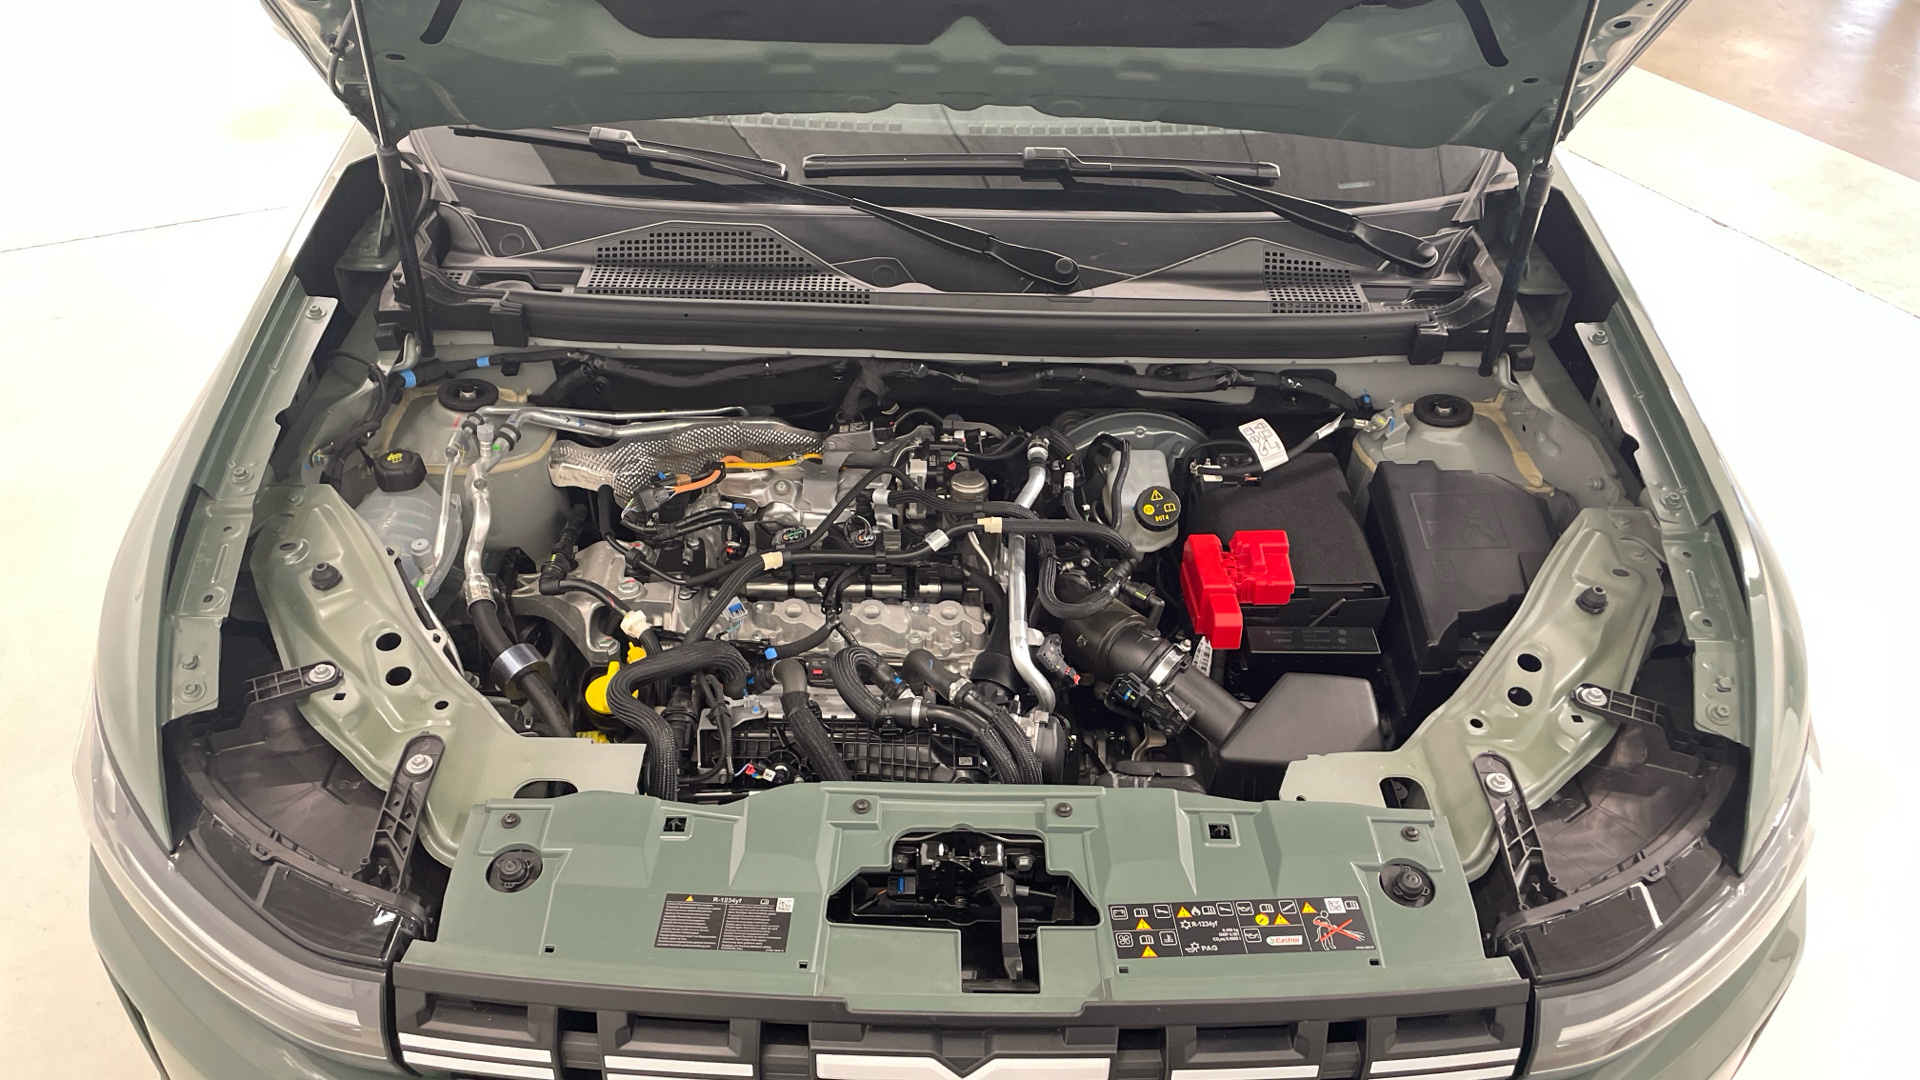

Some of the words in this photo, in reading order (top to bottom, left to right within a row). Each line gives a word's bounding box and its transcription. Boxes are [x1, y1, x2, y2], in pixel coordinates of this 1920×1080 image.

[712, 896, 742, 905] R-1234yf
[1191, 920, 1218, 928] R-1234yf
[1275, 937, 1300, 945] Castrol
